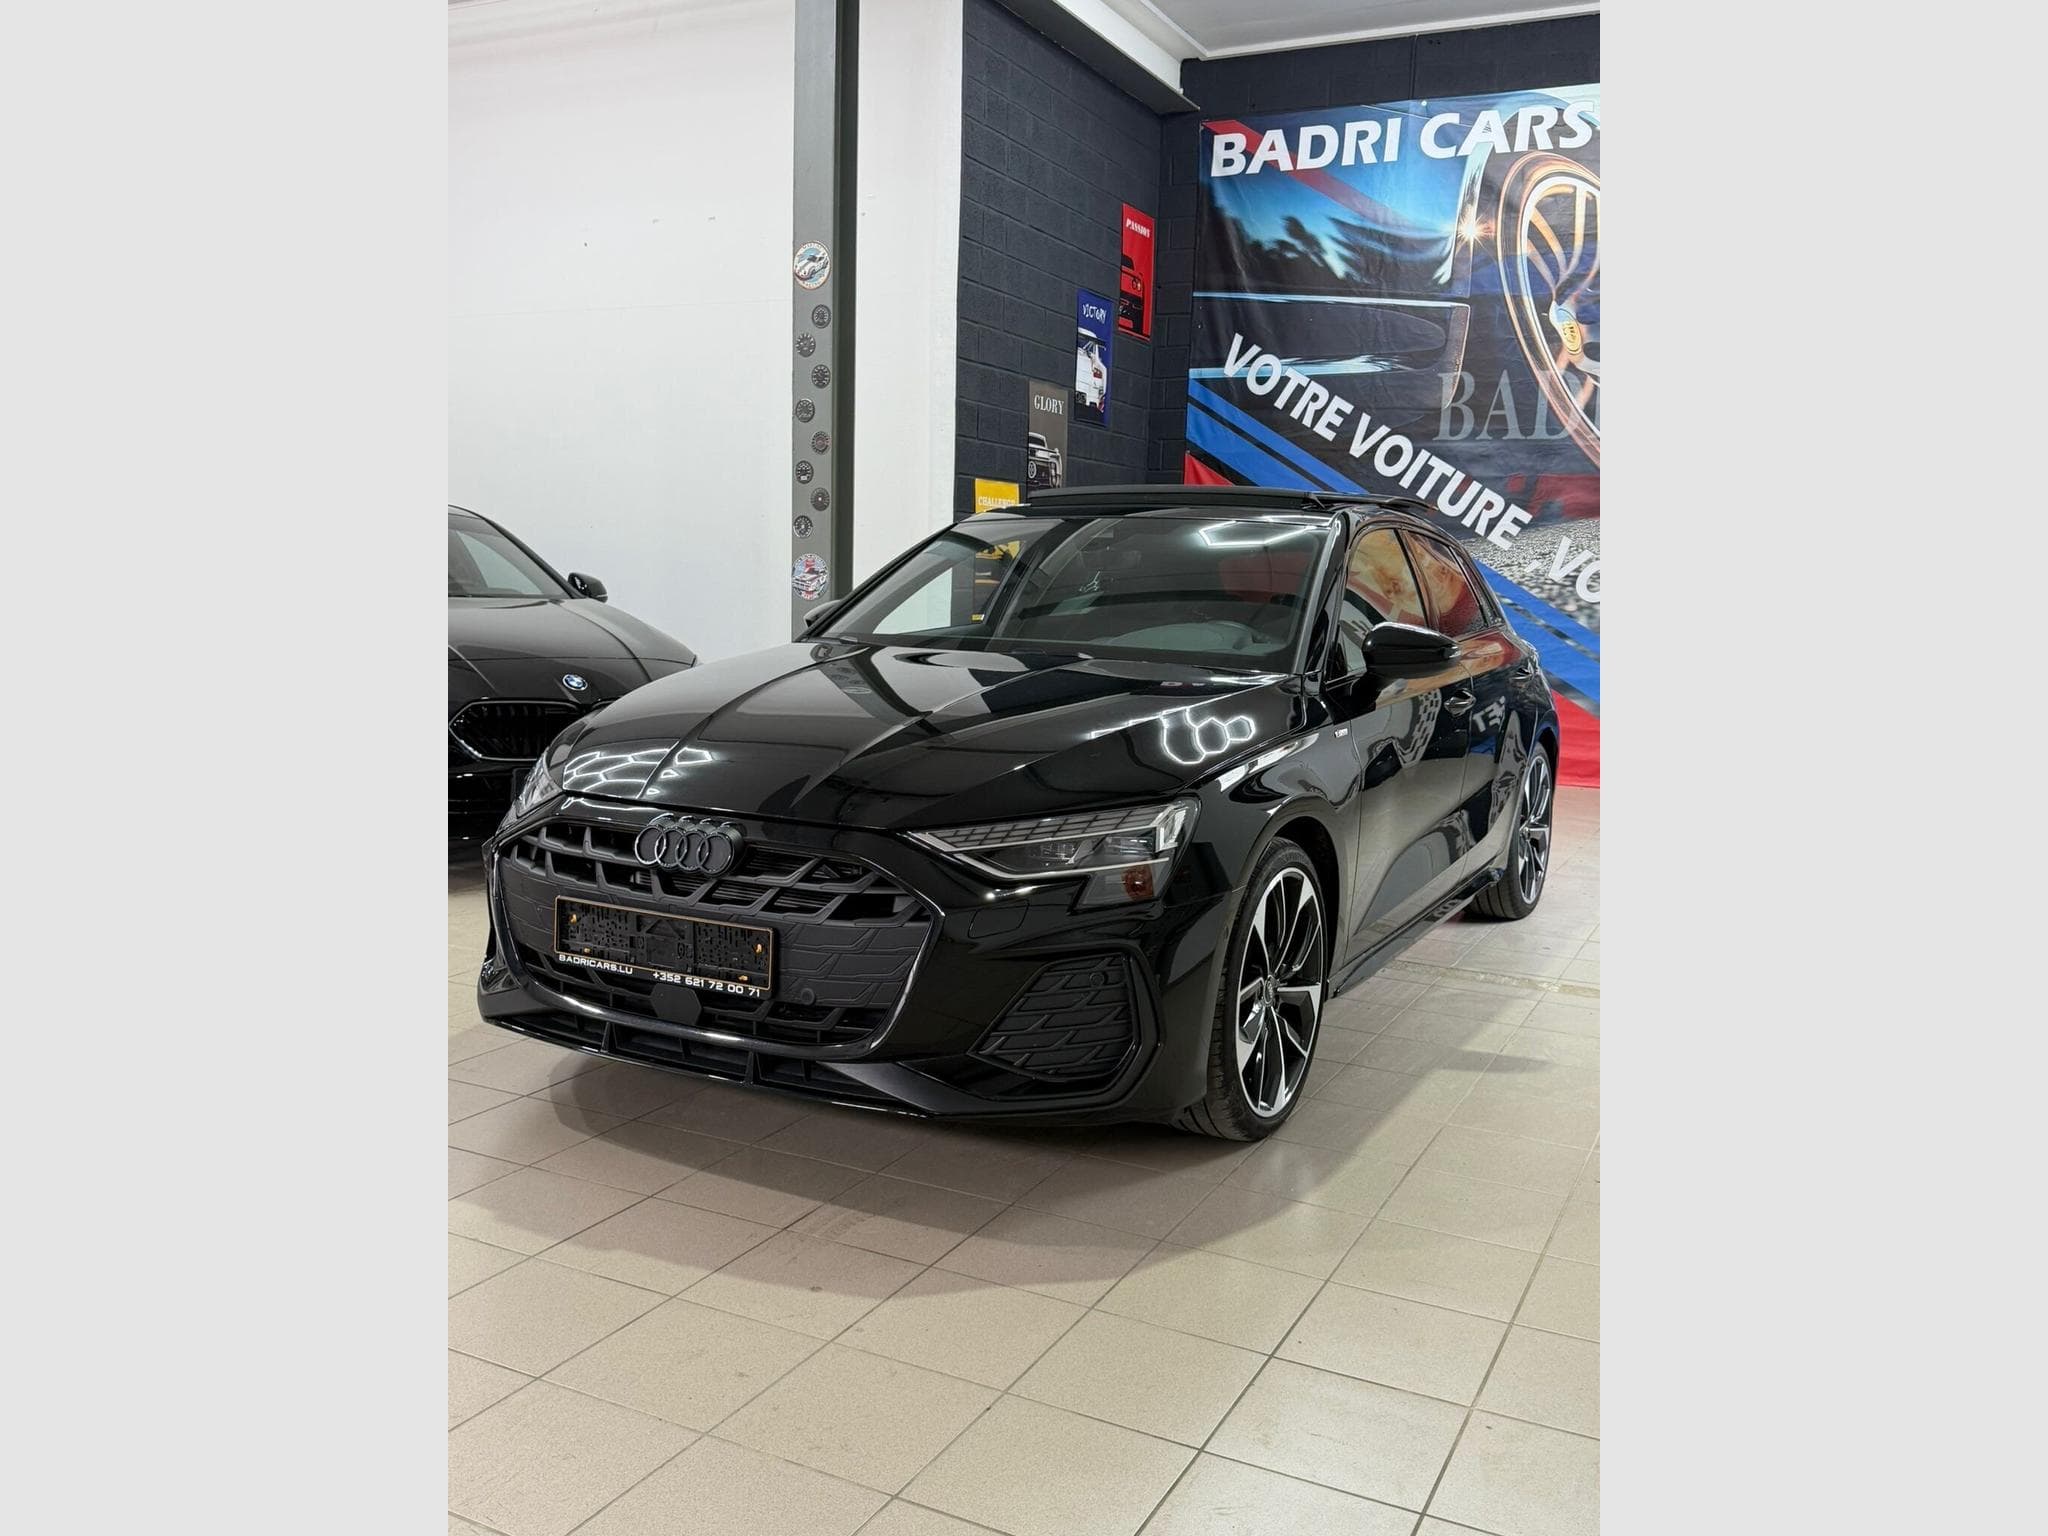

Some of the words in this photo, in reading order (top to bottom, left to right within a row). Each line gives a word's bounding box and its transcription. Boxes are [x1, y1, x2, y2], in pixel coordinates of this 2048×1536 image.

[1211, 117, 1401, 178] BADRI
[1420, 100, 1595, 159] CARS
[1034, 394, 1065, 415] GLORY
[1223, 333, 1354, 441] VOTRE
[1348, 412, 1533, 550] VOITURE
[558, 953, 633, 975] BADRICARS.LU
[653, 971, 682, 983] +352
[685, 977, 704, 987] 621
[708, 980, 724, 991] 72
[748, 987, 761, 998] 71
